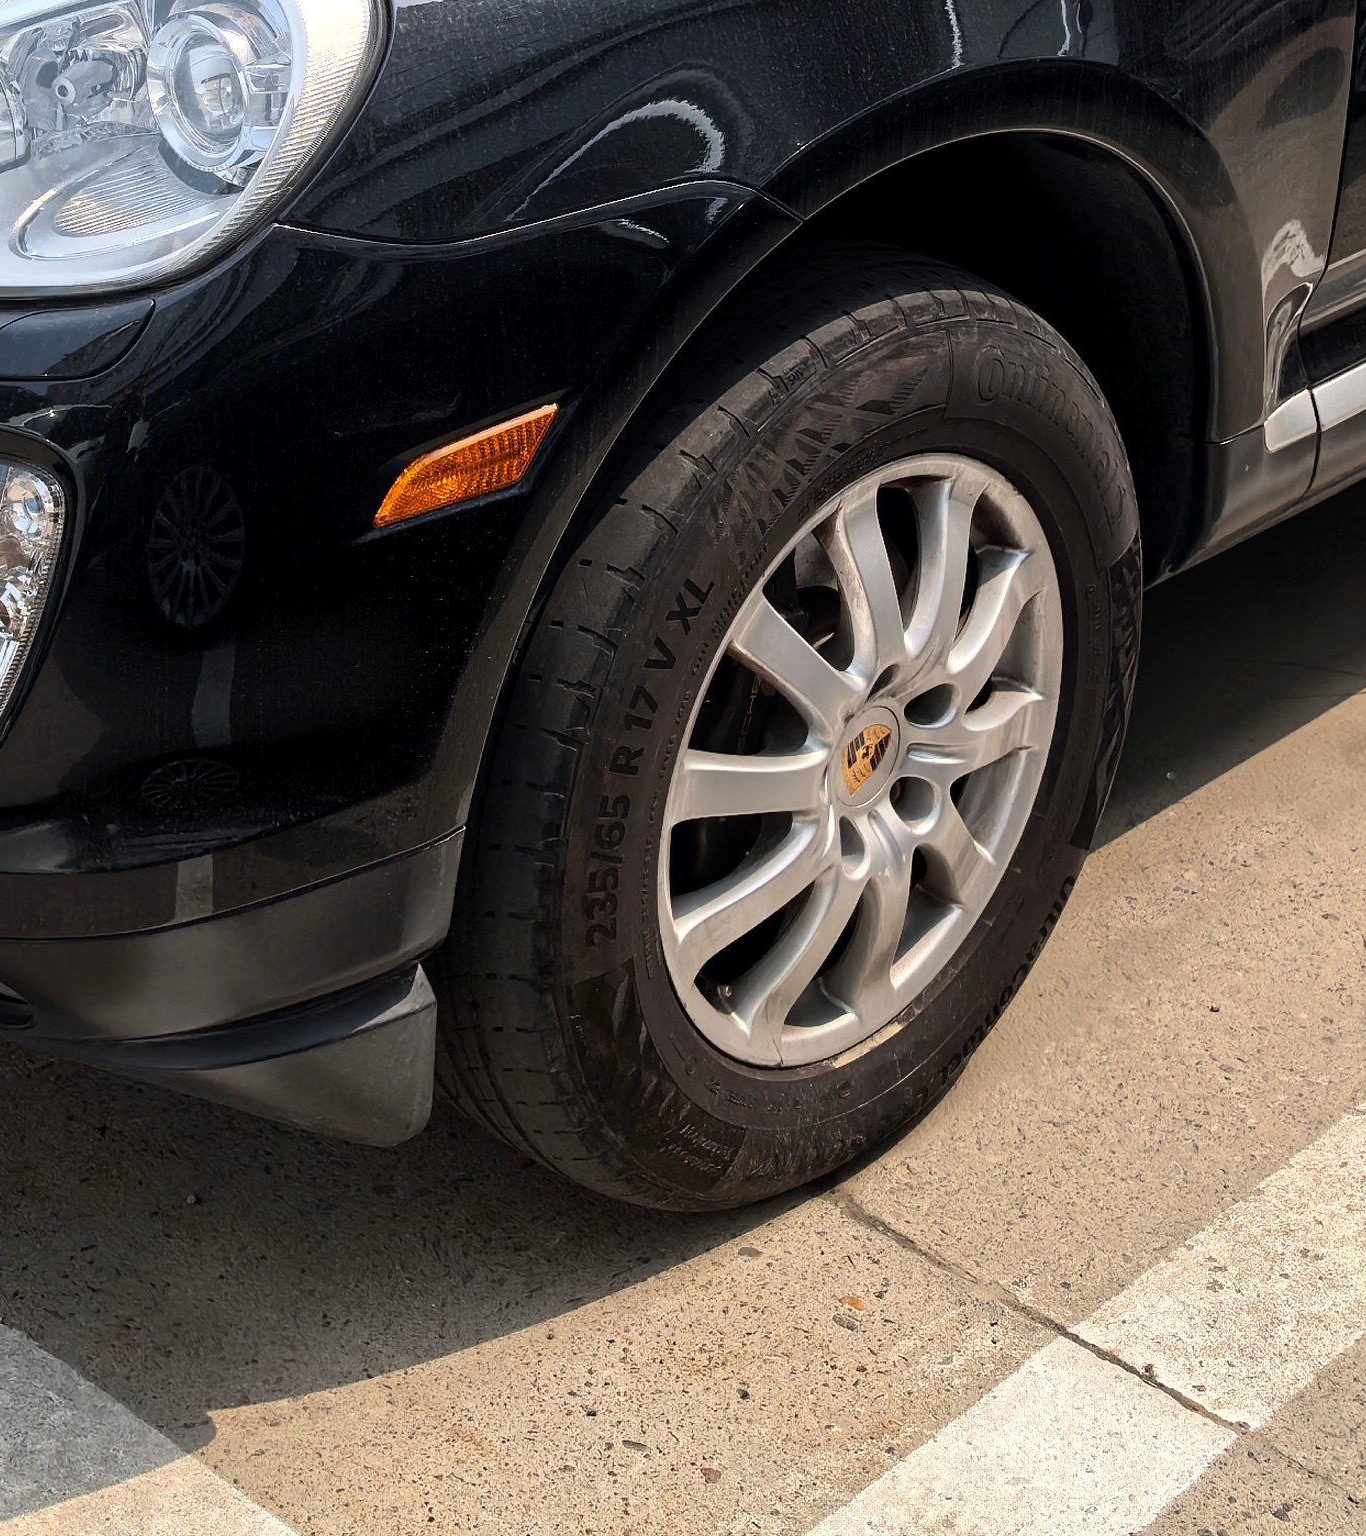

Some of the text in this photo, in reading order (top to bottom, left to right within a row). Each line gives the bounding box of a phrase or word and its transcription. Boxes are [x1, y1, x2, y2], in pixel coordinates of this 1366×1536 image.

[665, 577, 714, 635] XL
[643, 636, 677, 671] V
[624, 685, 659, 732] 17
[609, 745, 644, 775] R
[584, 794, 631, 947] 235/65
